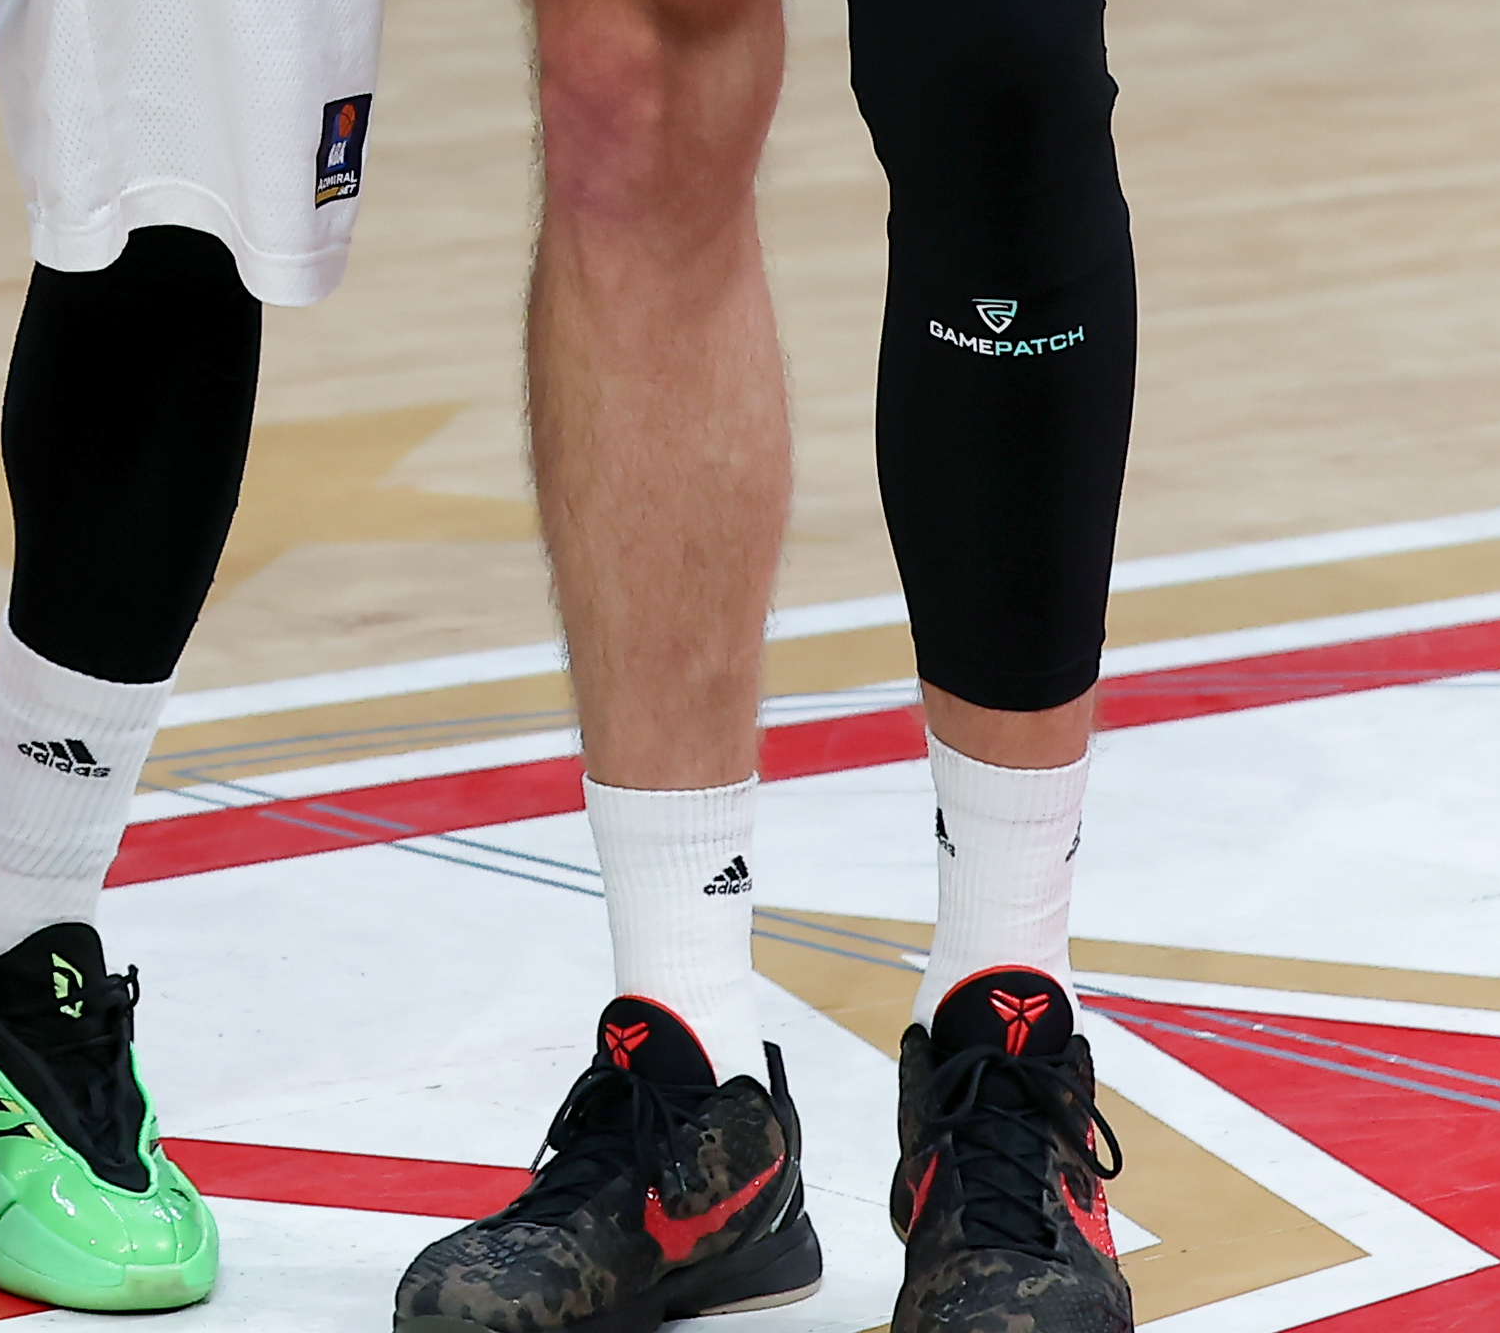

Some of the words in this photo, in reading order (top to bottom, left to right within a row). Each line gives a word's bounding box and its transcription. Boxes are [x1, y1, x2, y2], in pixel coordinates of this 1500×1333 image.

[317, 170, 358, 192] ADMIRAL
[929, 320, 1085, 356] GAMEPATCH
[17, 741, 111, 778] adidas
